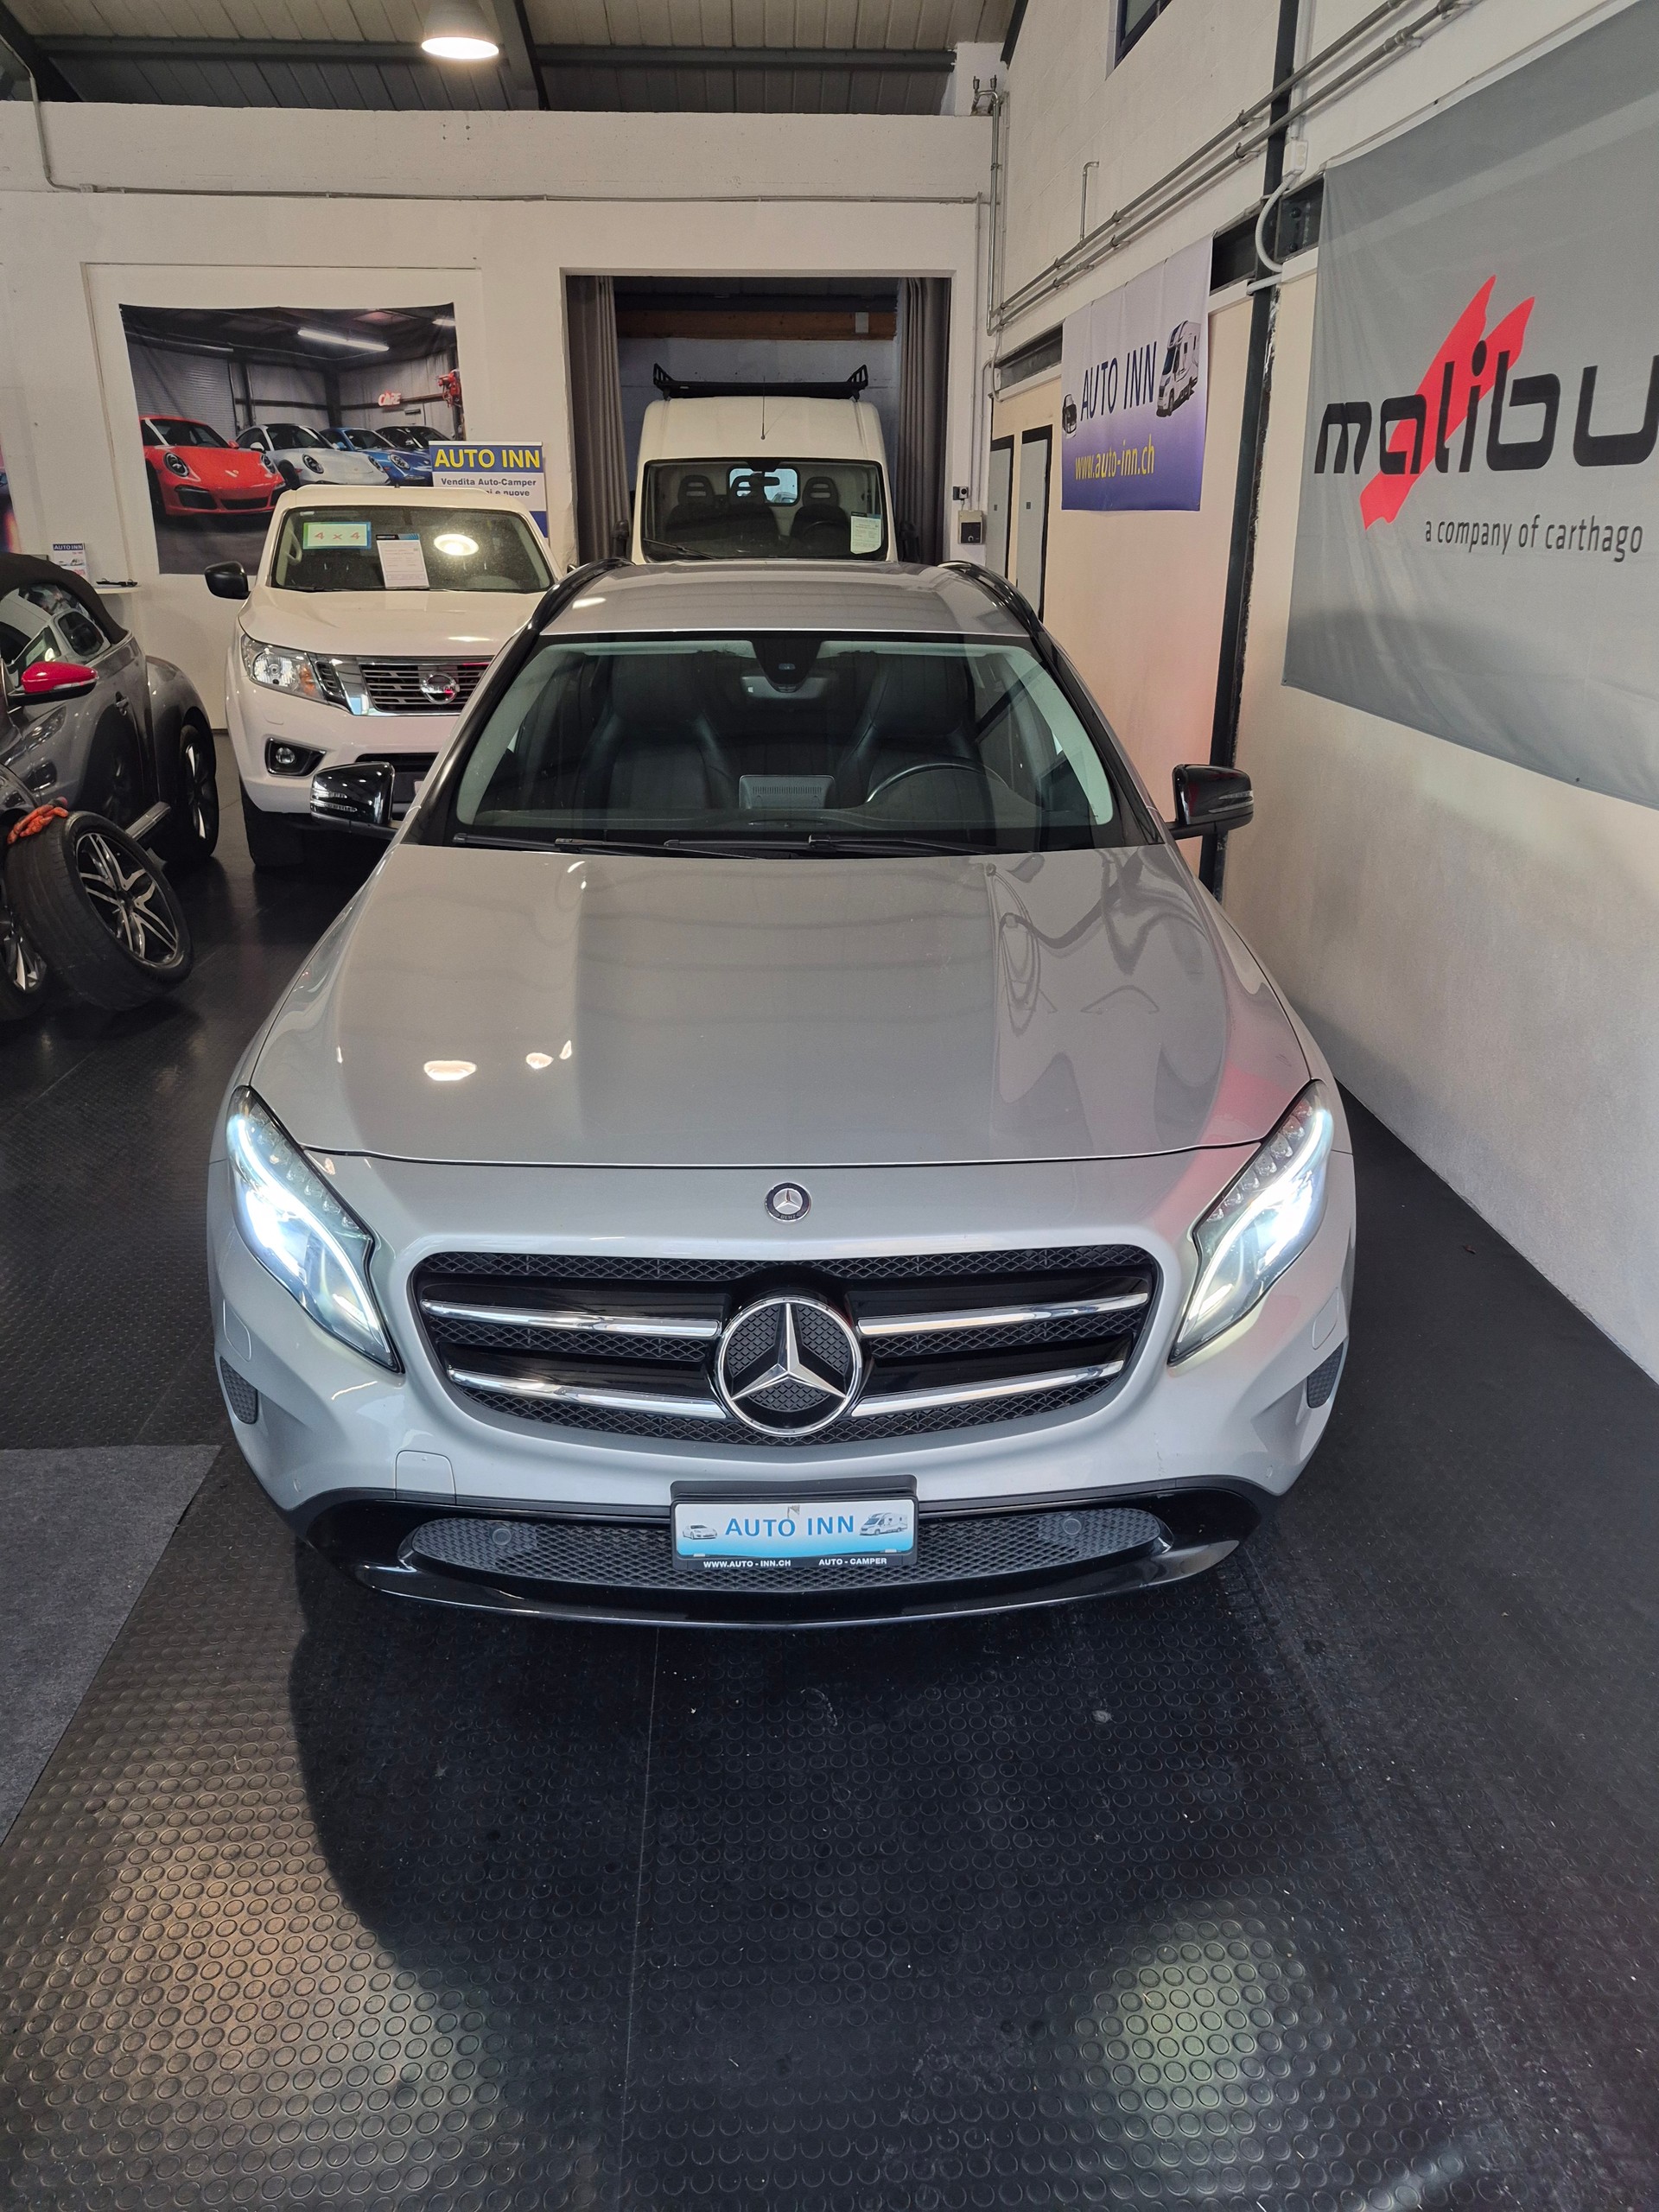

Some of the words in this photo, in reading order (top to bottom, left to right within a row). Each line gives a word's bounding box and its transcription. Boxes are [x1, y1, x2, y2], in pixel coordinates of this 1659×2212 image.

[1080, 357, 1118, 421] AUTO
[1124, 341, 1157, 410] INN
[1314, 340, 1659, 474] malibu
[435, 448, 495, 467] AUTO
[502, 449, 540, 468] INN
[1075, 434, 1155, 480] www.auto-inn.ch
[478, 478, 537, 487] Auto-Camper
[1425, 520, 1432, 543] a
[1437, 520, 1513, 555] company
[1518, 514, 1541, 548] of
[1545, 515, 1643, 563] carthago
[725, 1518, 796, 1537] AUTO
[807, 1515, 855, 1535] INN
[760, 1559, 791, 1567] INN.CH
